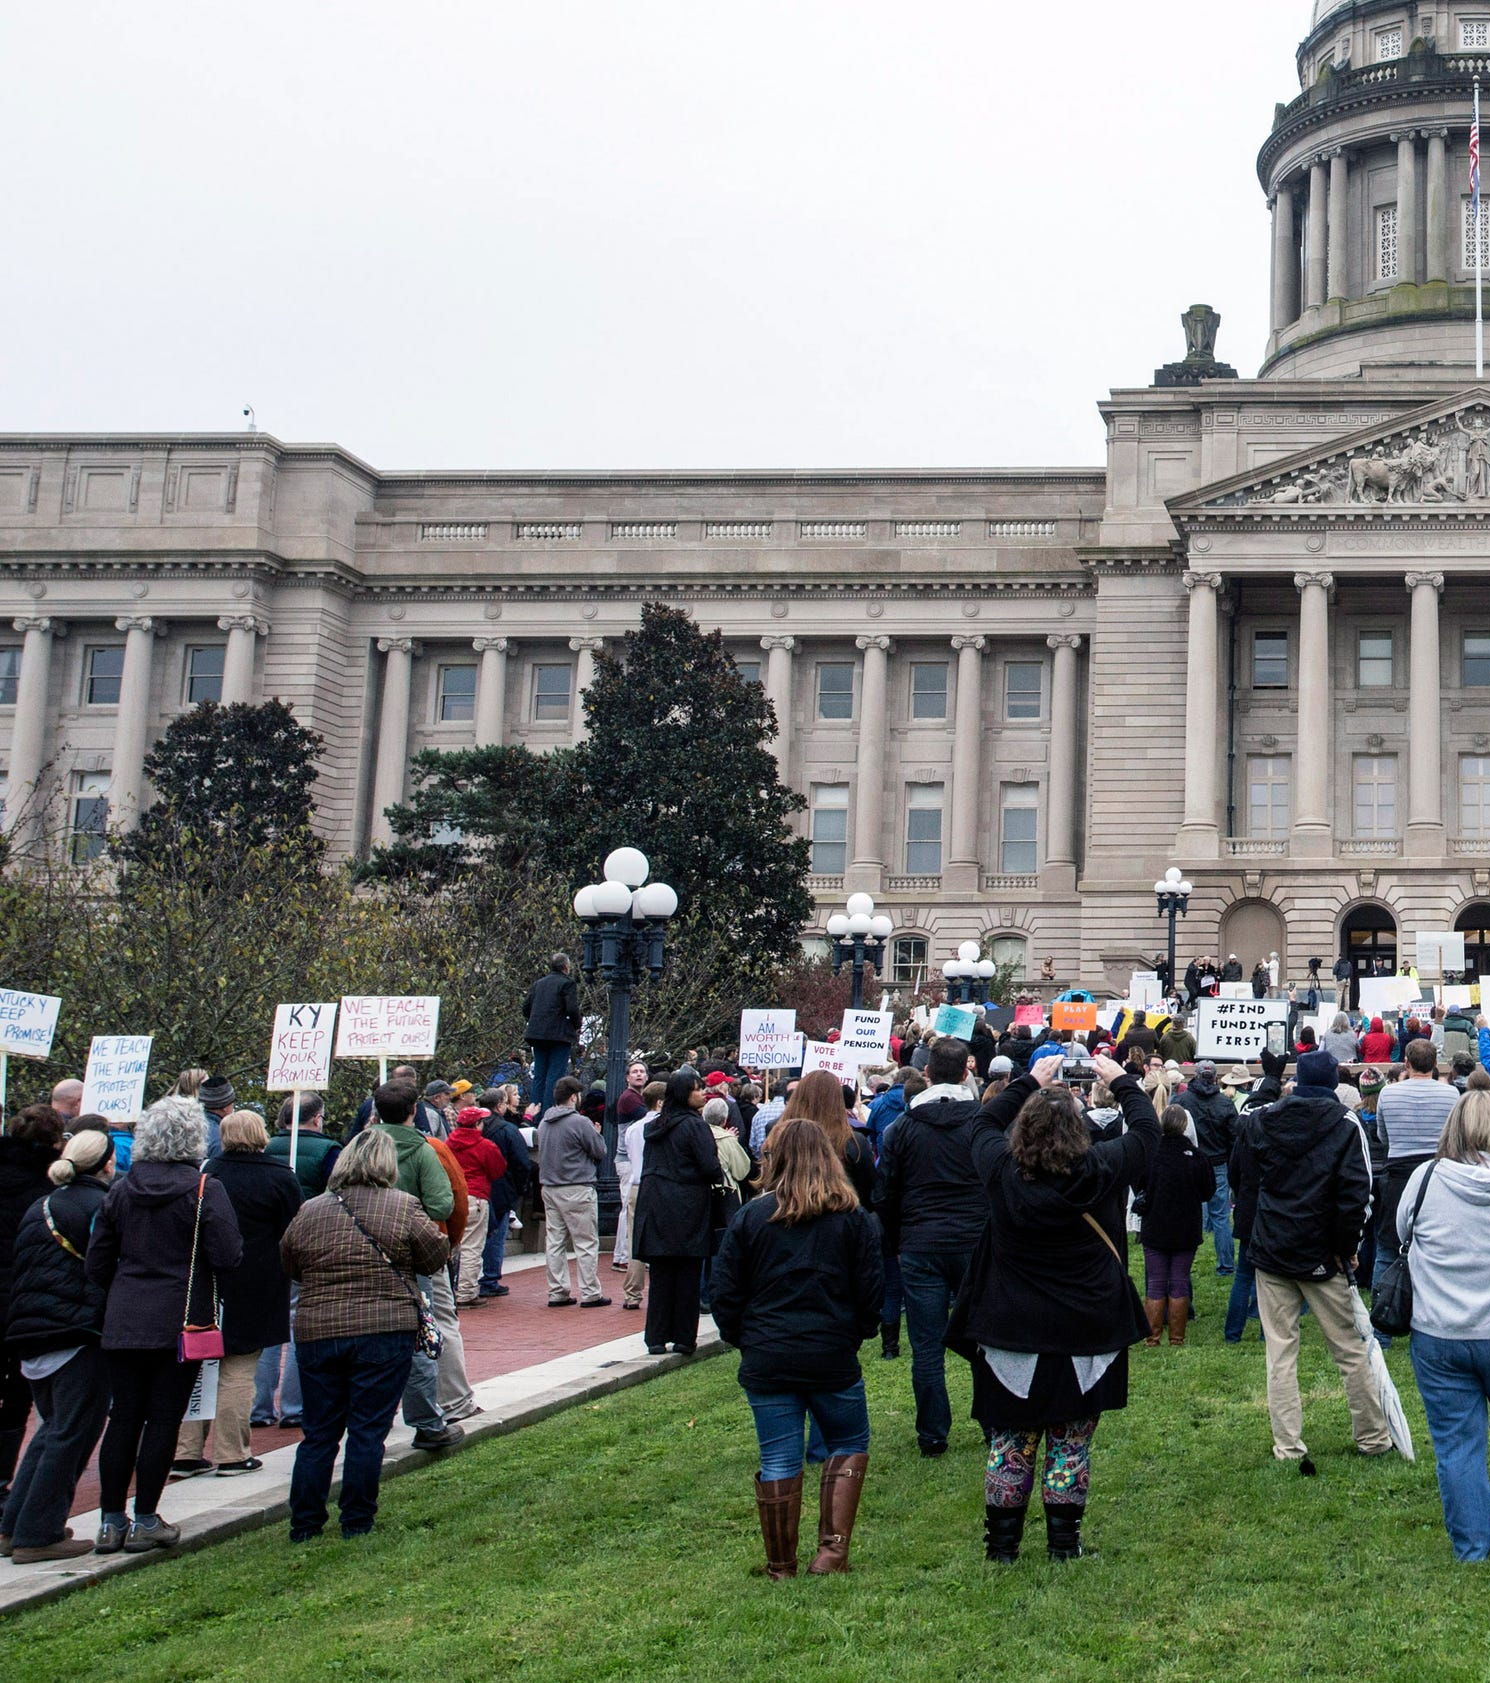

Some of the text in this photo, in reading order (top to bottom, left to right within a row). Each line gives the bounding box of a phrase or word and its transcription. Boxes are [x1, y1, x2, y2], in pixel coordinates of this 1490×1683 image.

[1344, 535, 1489, 551] COMMONWEALTH
[343, 998, 426, 1015] WE TEACH
[1063, 1005, 1088, 1013] PLAY
[1216, 1003, 1265, 1014] #FIND
[289, 1005, 322, 1029] KY
[350, 1014, 432, 1029] THE FUTURE
[854, 1015, 881, 1024] FUND
[1211, 1019, 1267, 1030] FUNDIN
[4, 1024, 53, 1045] PROMISE!
[757, 1023, 775, 1033] AM
[855, 1028, 876, 1036] OUR
[278, 1030, 325, 1050] KEEP
[347, 1030, 431, 1048] PROTECT OURS!
[745, 1033, 790, 1042] WORTH
[843, 1039, 885, 1049] PENSION
[1216, 1035, 1261, 1046] FIRST
[92, 1038, 150, 1057] WE TEACH
[757, 1044, 776, 1052] MY
[814, 1045, 835, 1056] VOTE
[279, 1050, 318, 1070] YOUR
[818, 1060, 844, 1071] OR BE
[92, 1060, 148, 1077] THE FUTURE
[272, 1056, 328, 1084] PROMISE!
[92, 1079, 140, 1094] PROTECT
[97, 1094, 133, 1113] OURS!
[190, 1367, 203, 1416] ROMISE
